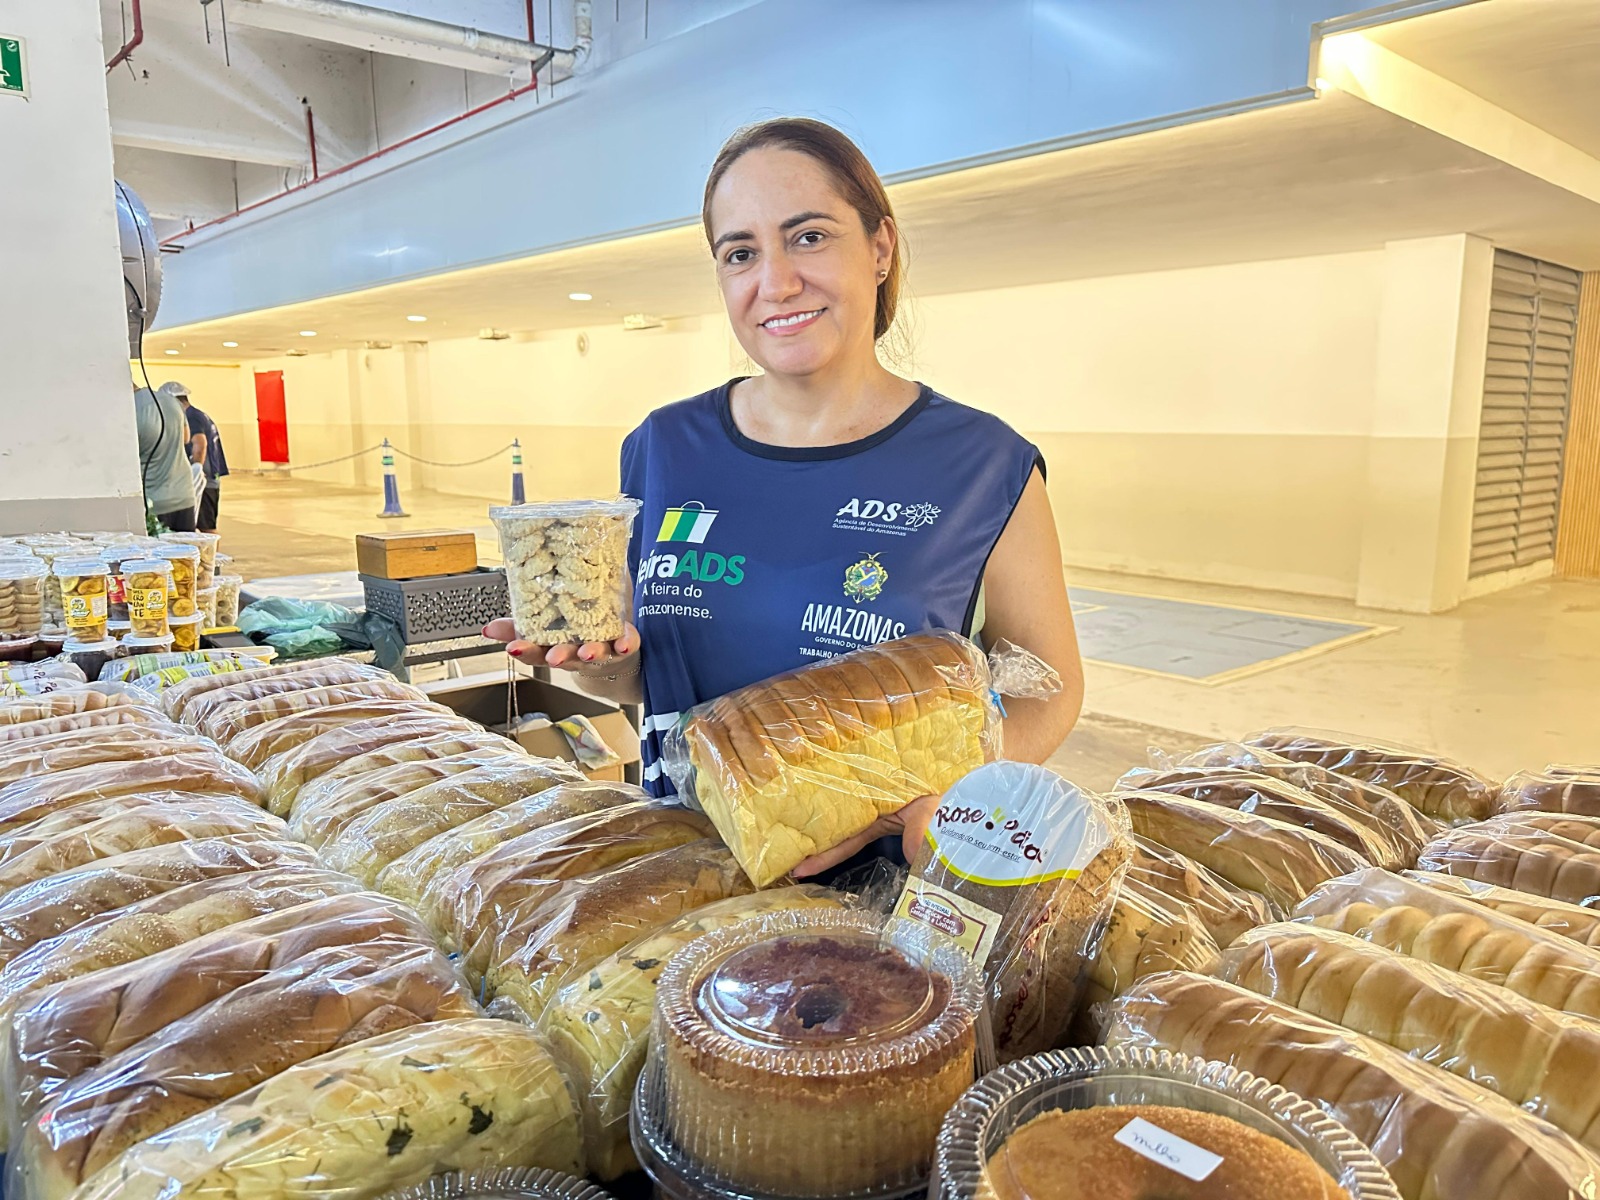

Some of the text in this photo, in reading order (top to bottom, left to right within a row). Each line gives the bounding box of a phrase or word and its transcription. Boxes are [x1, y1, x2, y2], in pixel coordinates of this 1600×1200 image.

[836, 498, 902, 522] ADS
[875, 528, 907, 537] Amazonas
[642, 582, 703, 599] A feira do
[801, 603, 906, 645] AMAZONAS
[815, 636, 845, 647] GOVERNO
[799, 647, 832, 659] TRABALHO
[936, 805, 987, 828] Rose
[974, 839, 988, 850] seu
